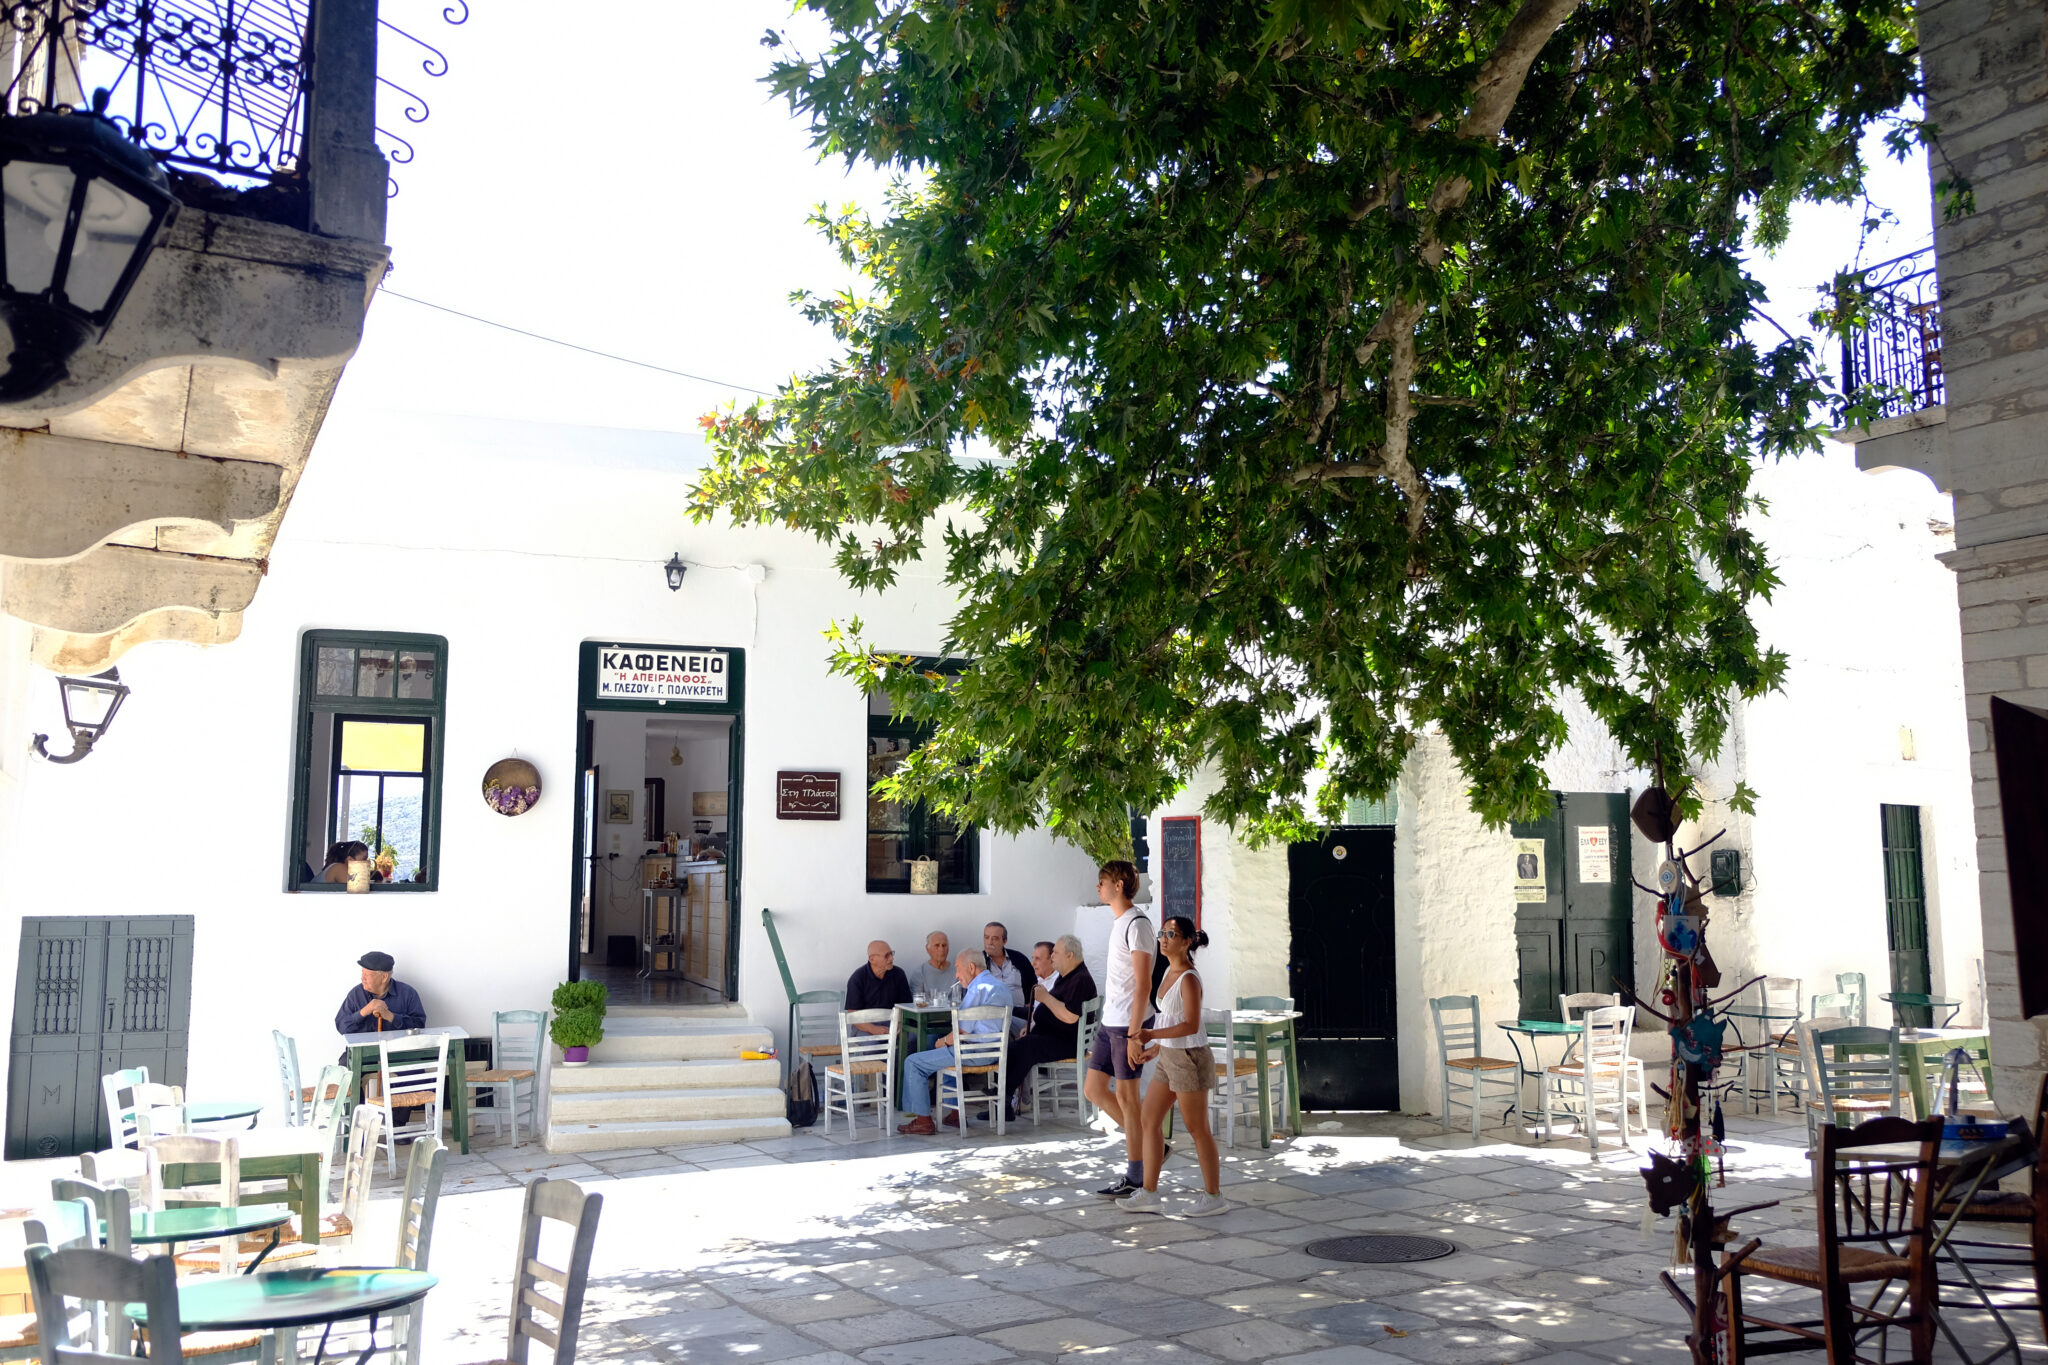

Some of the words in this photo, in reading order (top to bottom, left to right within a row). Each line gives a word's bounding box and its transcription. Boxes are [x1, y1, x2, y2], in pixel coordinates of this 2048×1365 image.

[603, 652, 724, 674] ΚΑΦΕΝΕΙΟ
[603, 683, 612, 692] Μ.
[614, 683, 649, 693] ΓΛΕΖΟΥ
[658, 685, 664, 695] Γ.
[667, 685, 723, 696] ΠΟΛΥΚΡΕΤΗ
